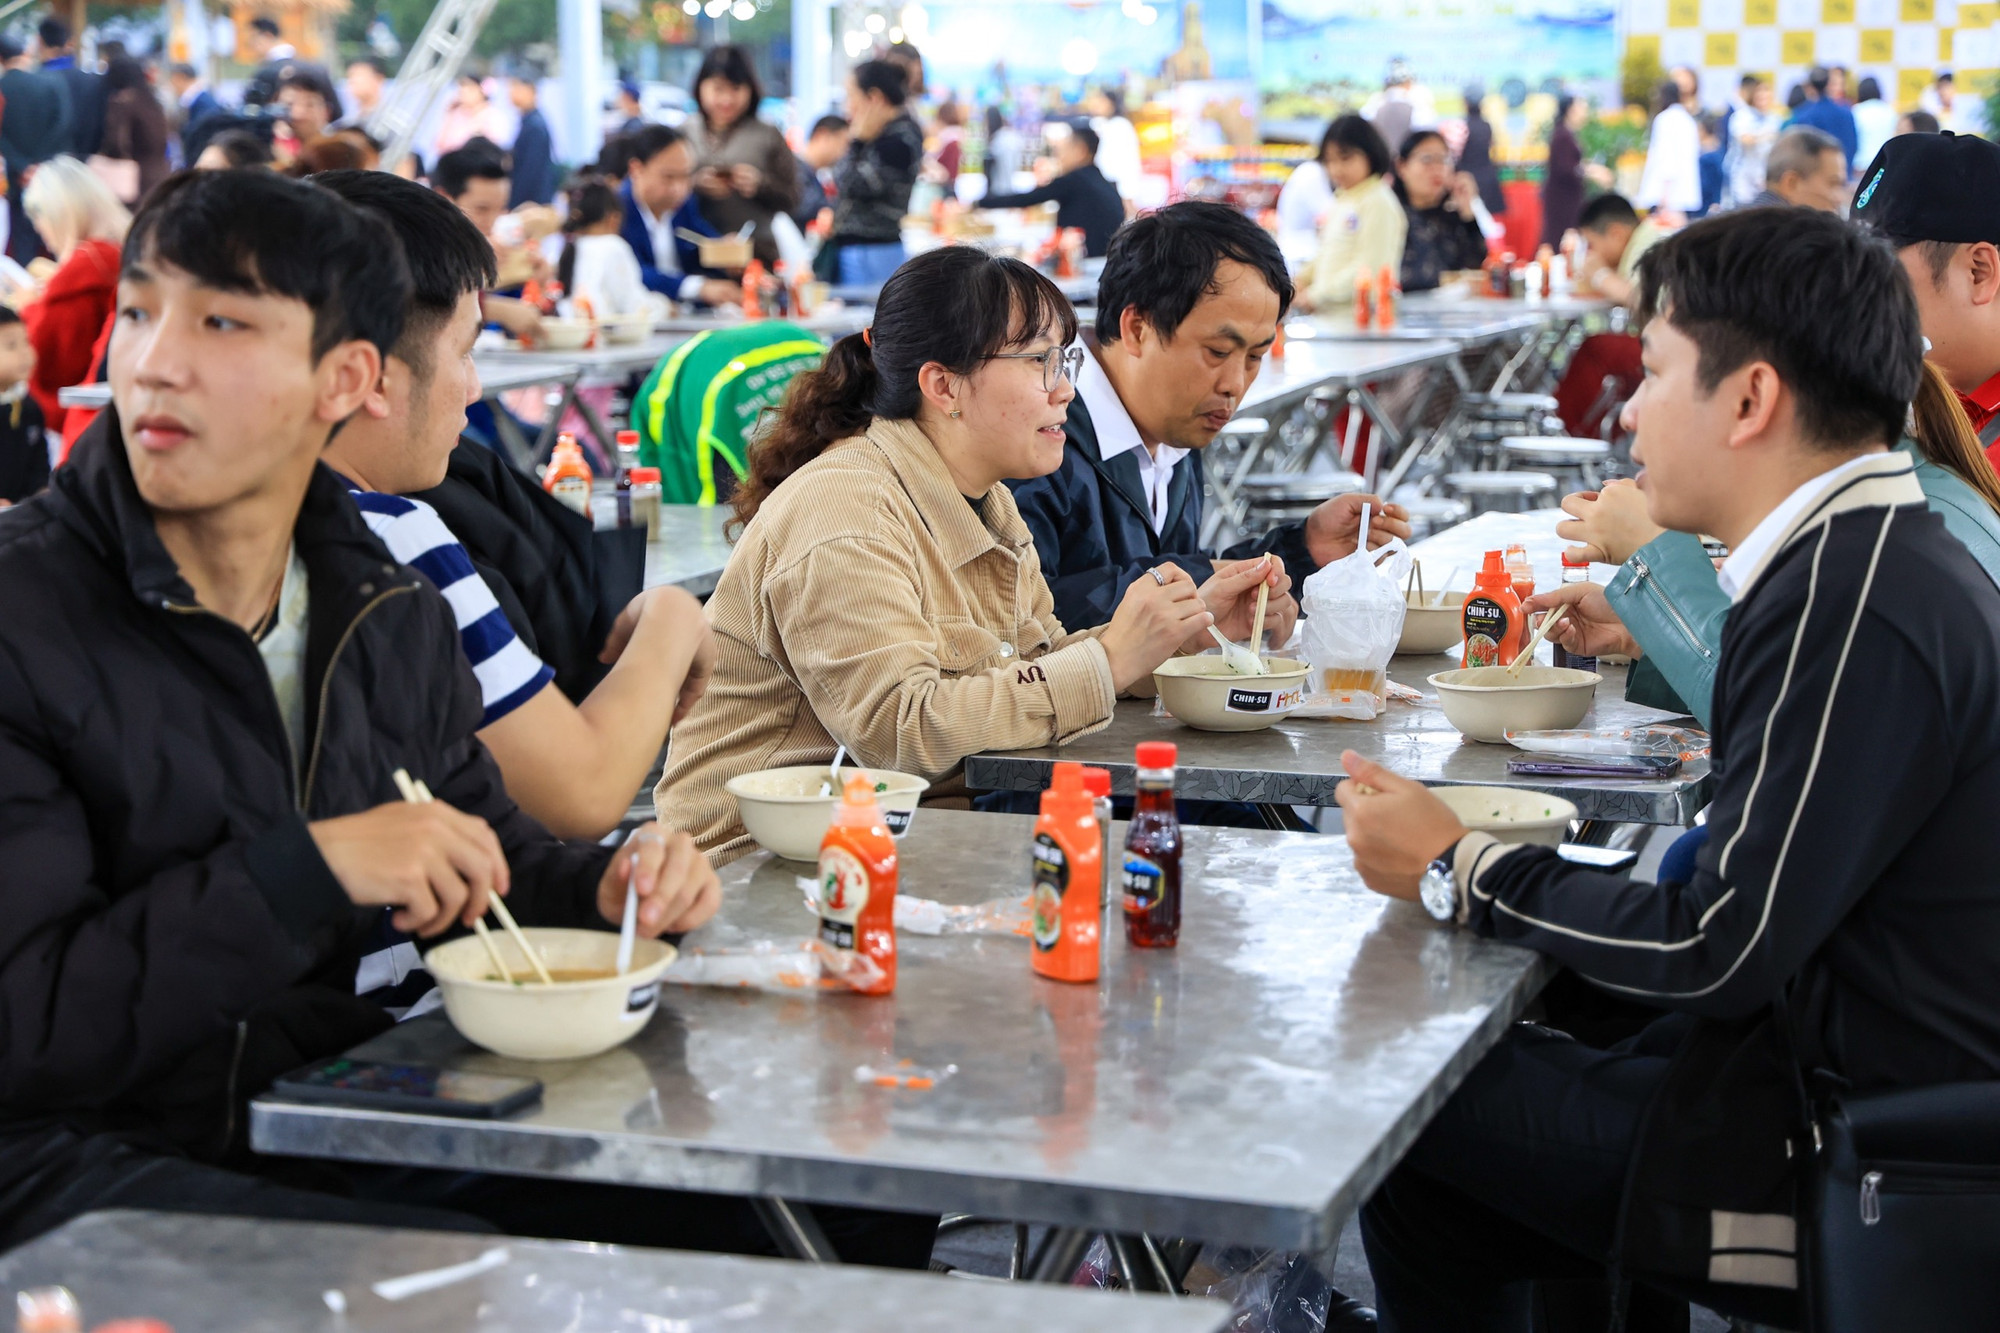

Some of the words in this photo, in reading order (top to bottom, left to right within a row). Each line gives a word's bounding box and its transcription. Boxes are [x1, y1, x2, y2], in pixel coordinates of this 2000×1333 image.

[1466, 605, 1500, 618] CHIN-SU
[1017, 665, 1047, 685] UY
[1232, 693, 1268, 704] CHIN-SU
